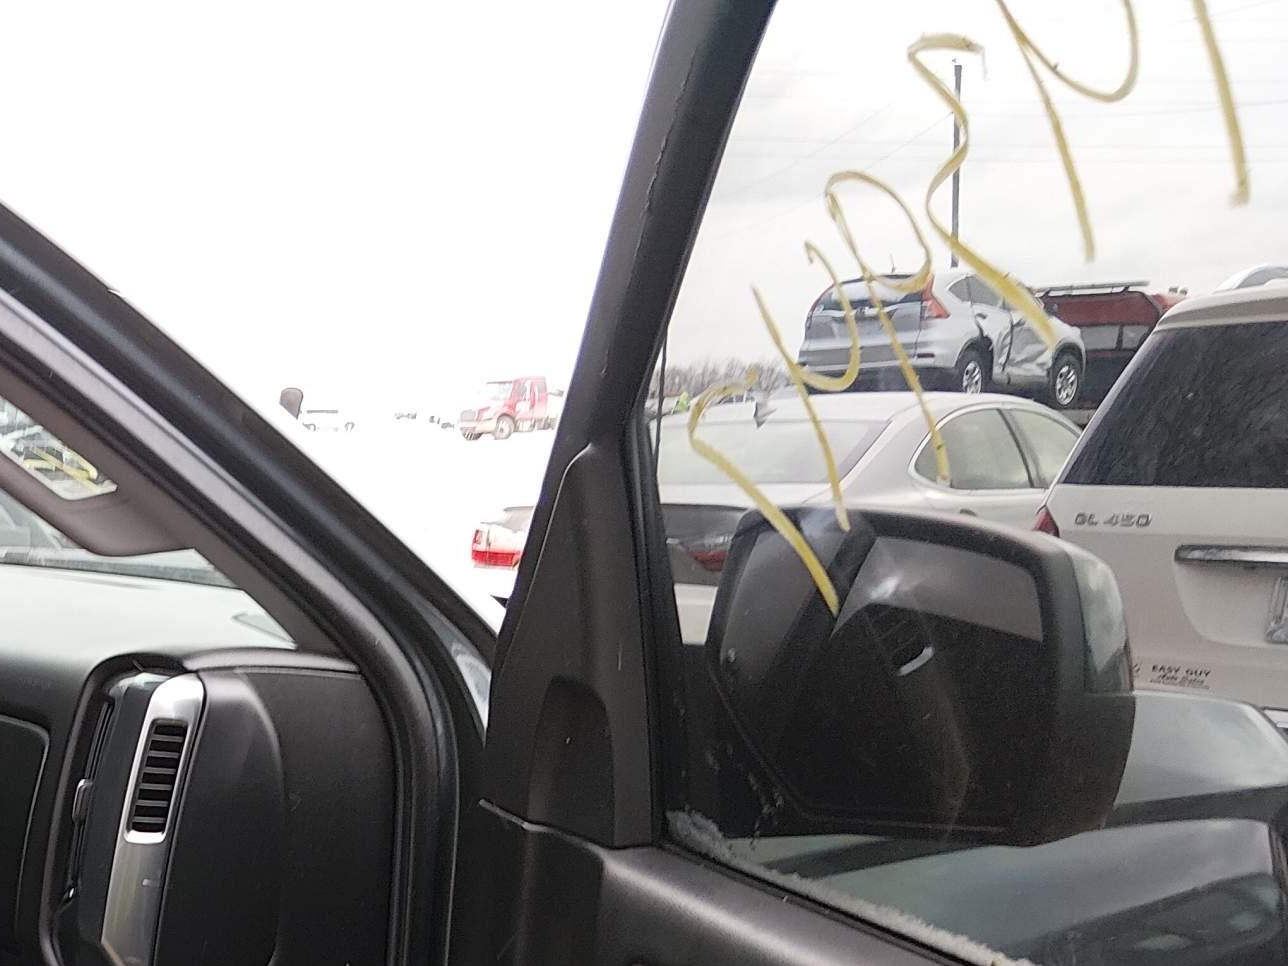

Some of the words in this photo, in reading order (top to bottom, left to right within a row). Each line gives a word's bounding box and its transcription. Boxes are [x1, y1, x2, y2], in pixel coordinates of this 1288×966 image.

[1074, 512, 1099, 527] GL
[1103, 512, 1153, 528] 450
[1151, 664, 1181, 674] EASY
[1185, 668, 1211, 677] GUY
